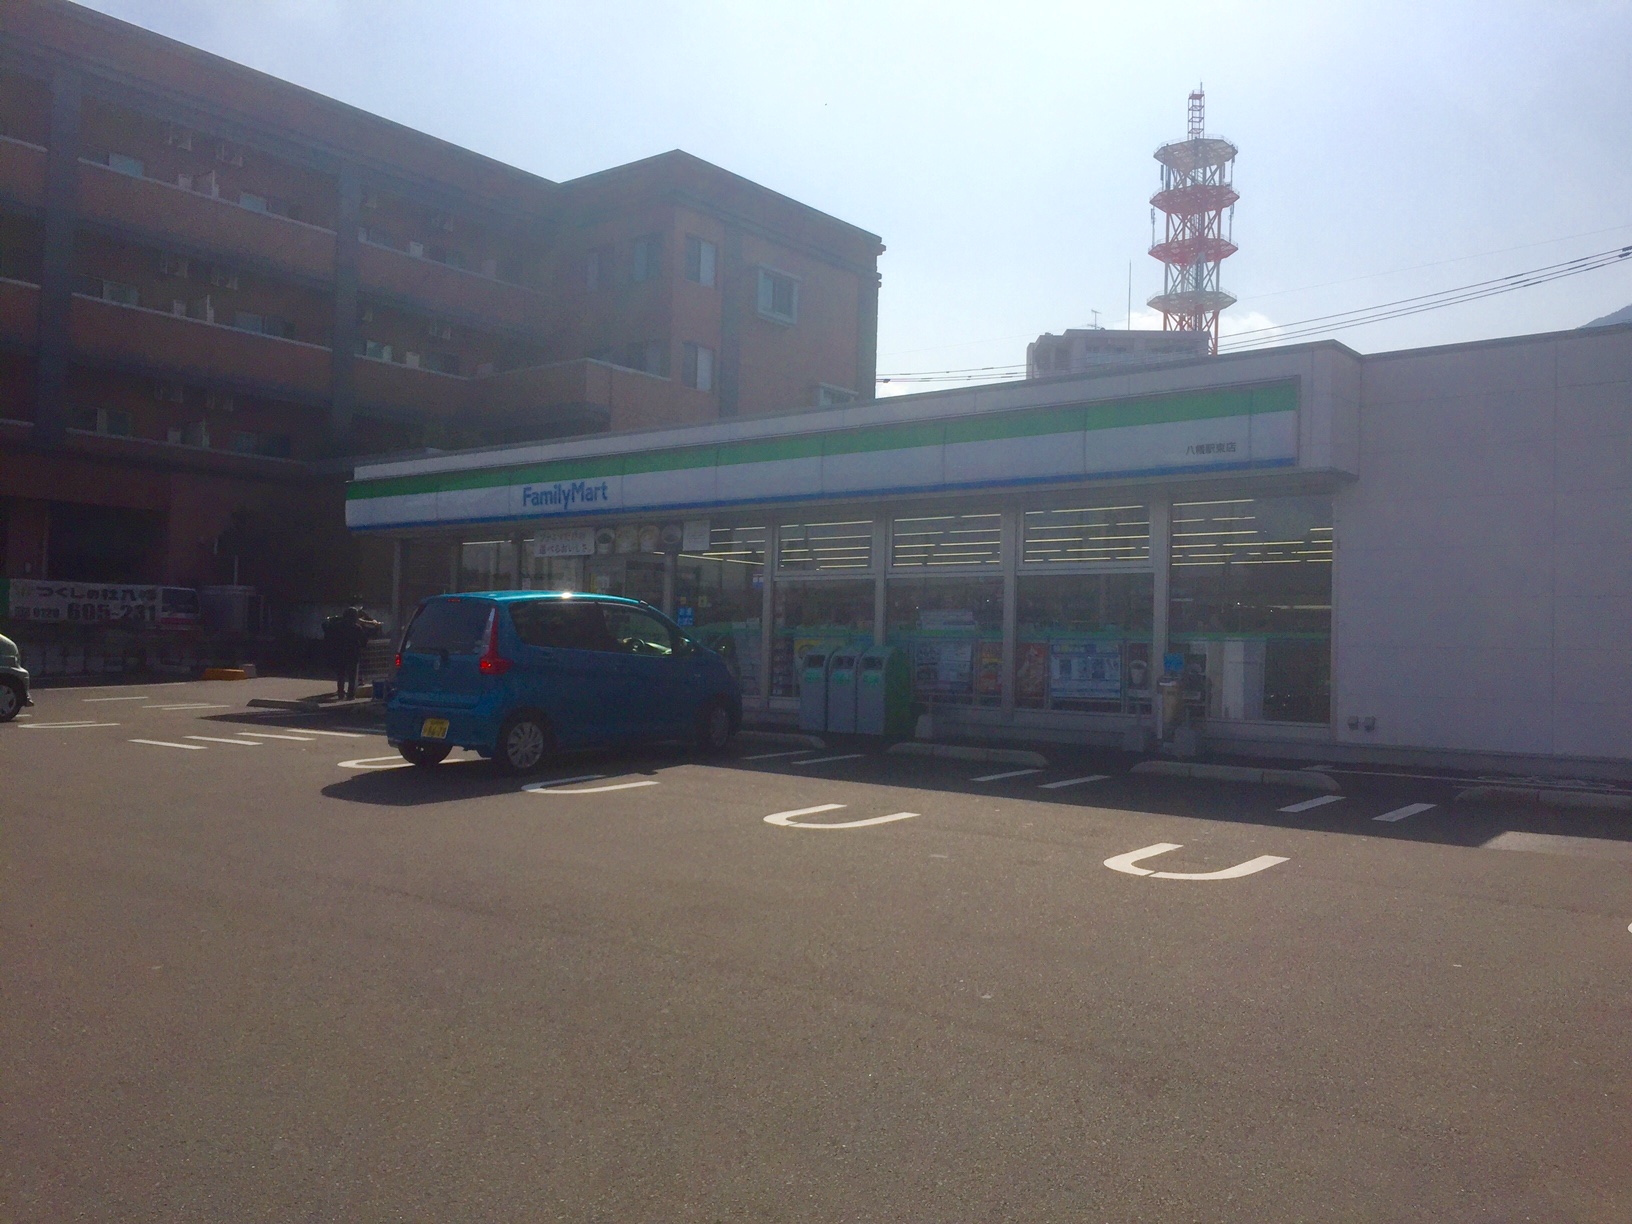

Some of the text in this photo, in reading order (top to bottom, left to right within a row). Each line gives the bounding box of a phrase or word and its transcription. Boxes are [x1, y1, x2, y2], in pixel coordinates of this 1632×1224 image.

[1186, 442, 1236, 455] 八幡駅東店
[523, 481, 608, 510] FamilyMart
